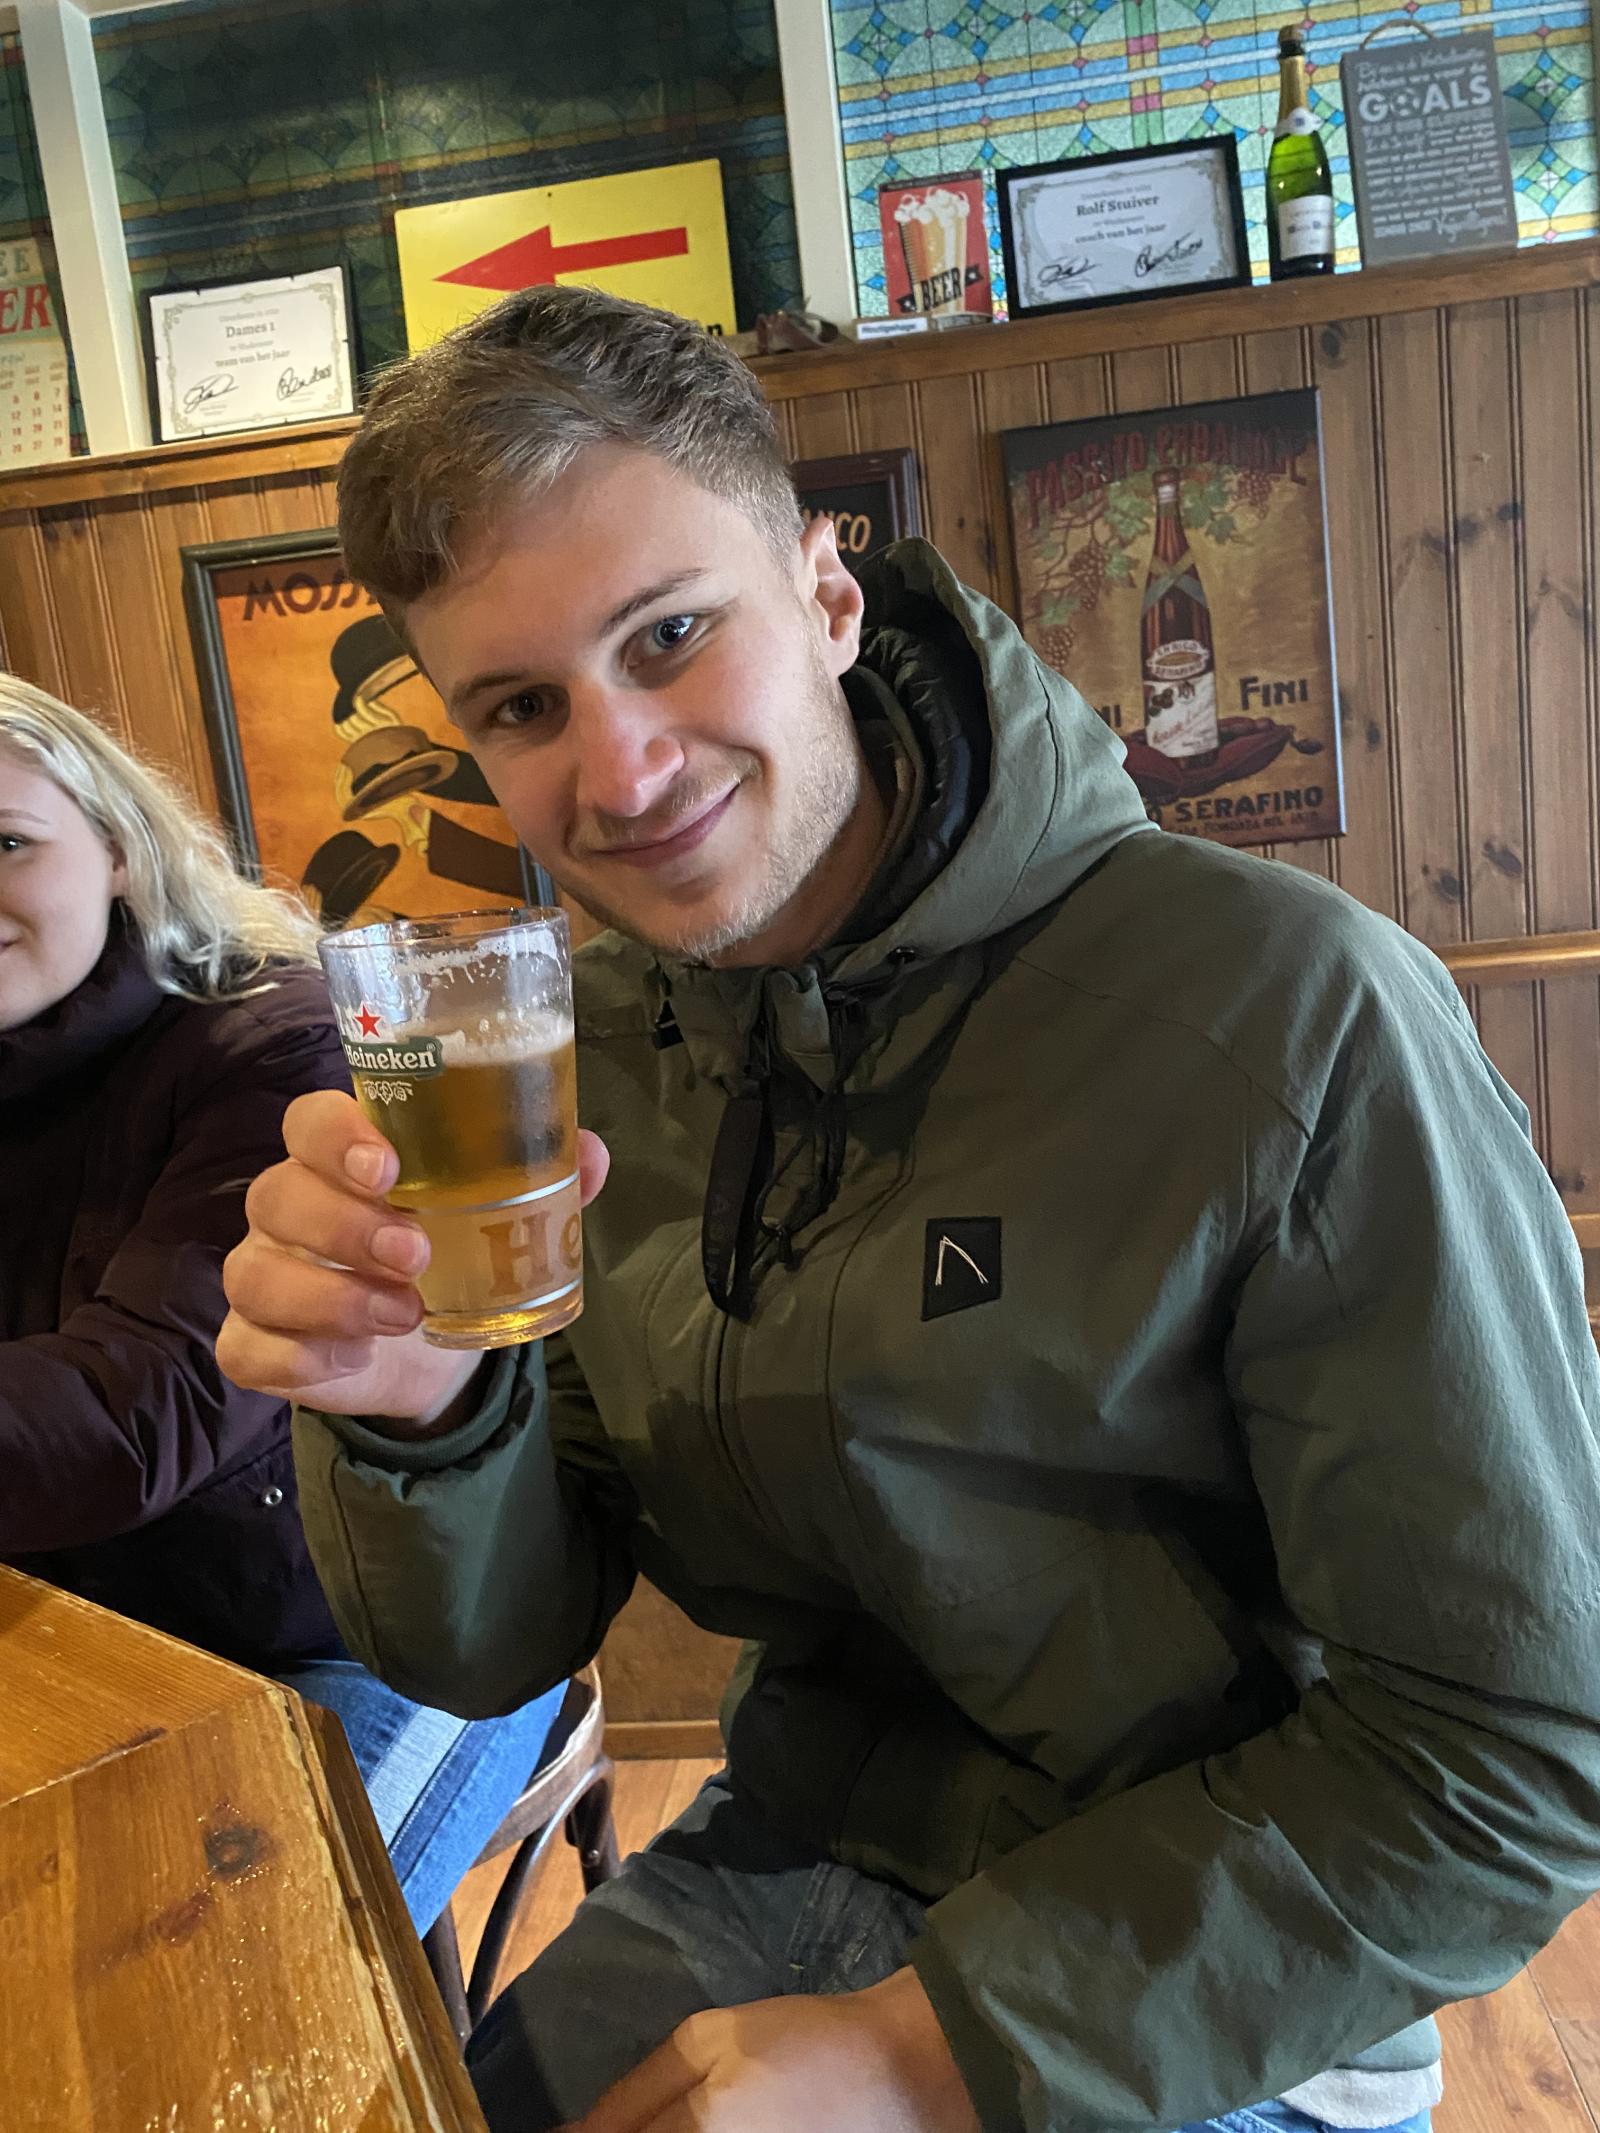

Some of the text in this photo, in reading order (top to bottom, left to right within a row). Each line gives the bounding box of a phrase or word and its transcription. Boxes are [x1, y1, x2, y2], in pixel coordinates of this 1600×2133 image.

[1359, 75, 1492, 122] GOALS
[1076, 194, 1159, 217] Rolf Stuiver
[1107, 229, 1125, 240] van
[1127, 225, 1144, 237] het
[1145, 223, 1167, 236] jaar
[921, 267, 963, 311] BEER
[226, 322, 268, 339] Dames
[240, 354, 255, 365] van
[256, 351, 272, 363] het
[272, 349, 291, 361] jaar
[243, 567, 378, 621] MOSS
[1239, 676, 1308, 711] FINI
[1175, 785, 1324, 823] SERAFINO
[345, 1043, 437, 1070] Heineken
